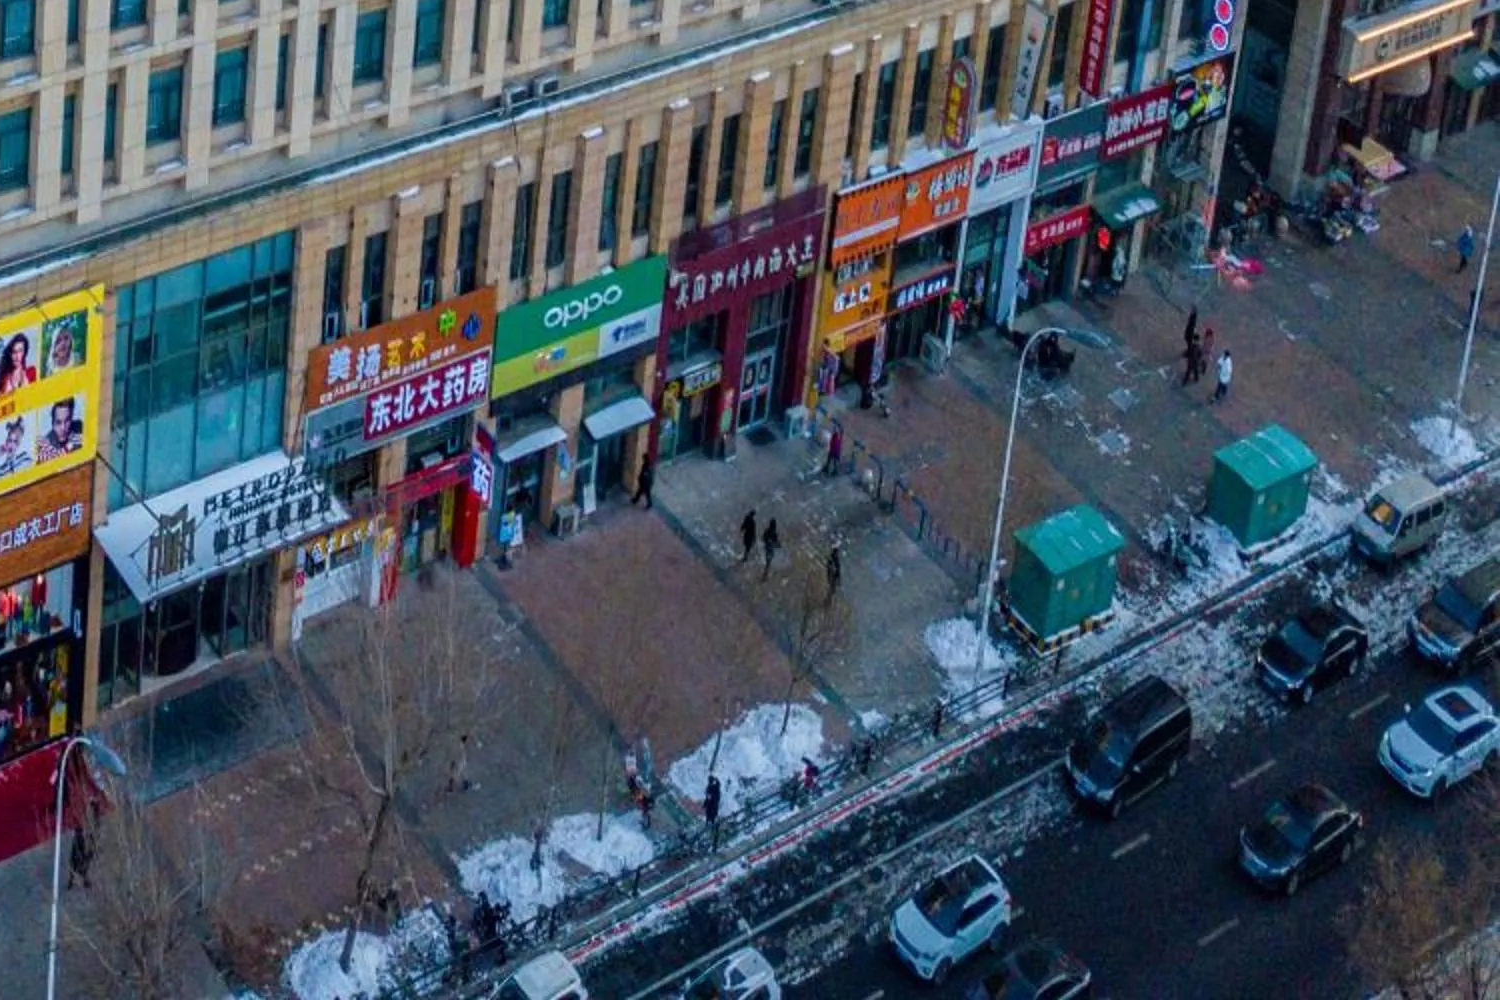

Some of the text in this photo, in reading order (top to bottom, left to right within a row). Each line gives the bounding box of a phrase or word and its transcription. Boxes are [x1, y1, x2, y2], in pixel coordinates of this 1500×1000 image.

[369, 358, 488, 434] 东北大药房
